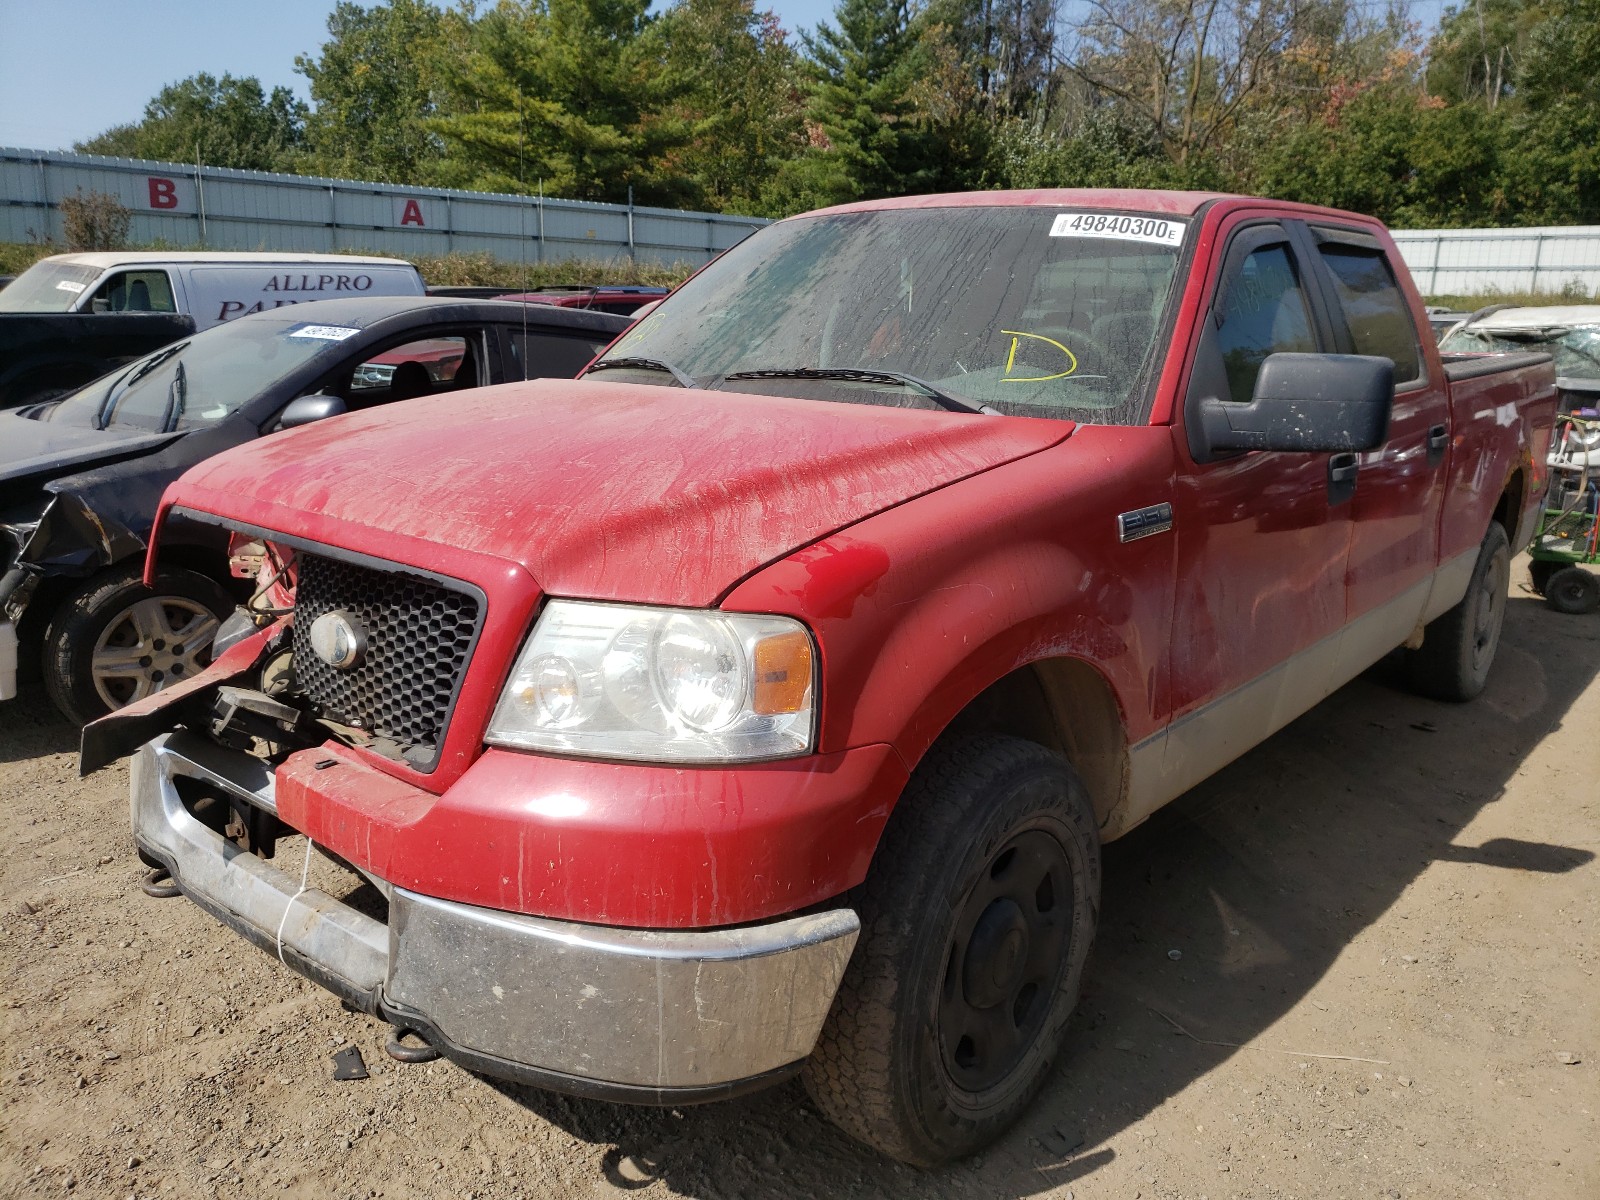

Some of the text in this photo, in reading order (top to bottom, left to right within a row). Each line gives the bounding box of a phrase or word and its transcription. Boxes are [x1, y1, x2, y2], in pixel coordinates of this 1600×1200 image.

[148, 177, 178, 209] B
[400, 199, 425, 227] A
[262, 274, 373, 292] ALLPRO
